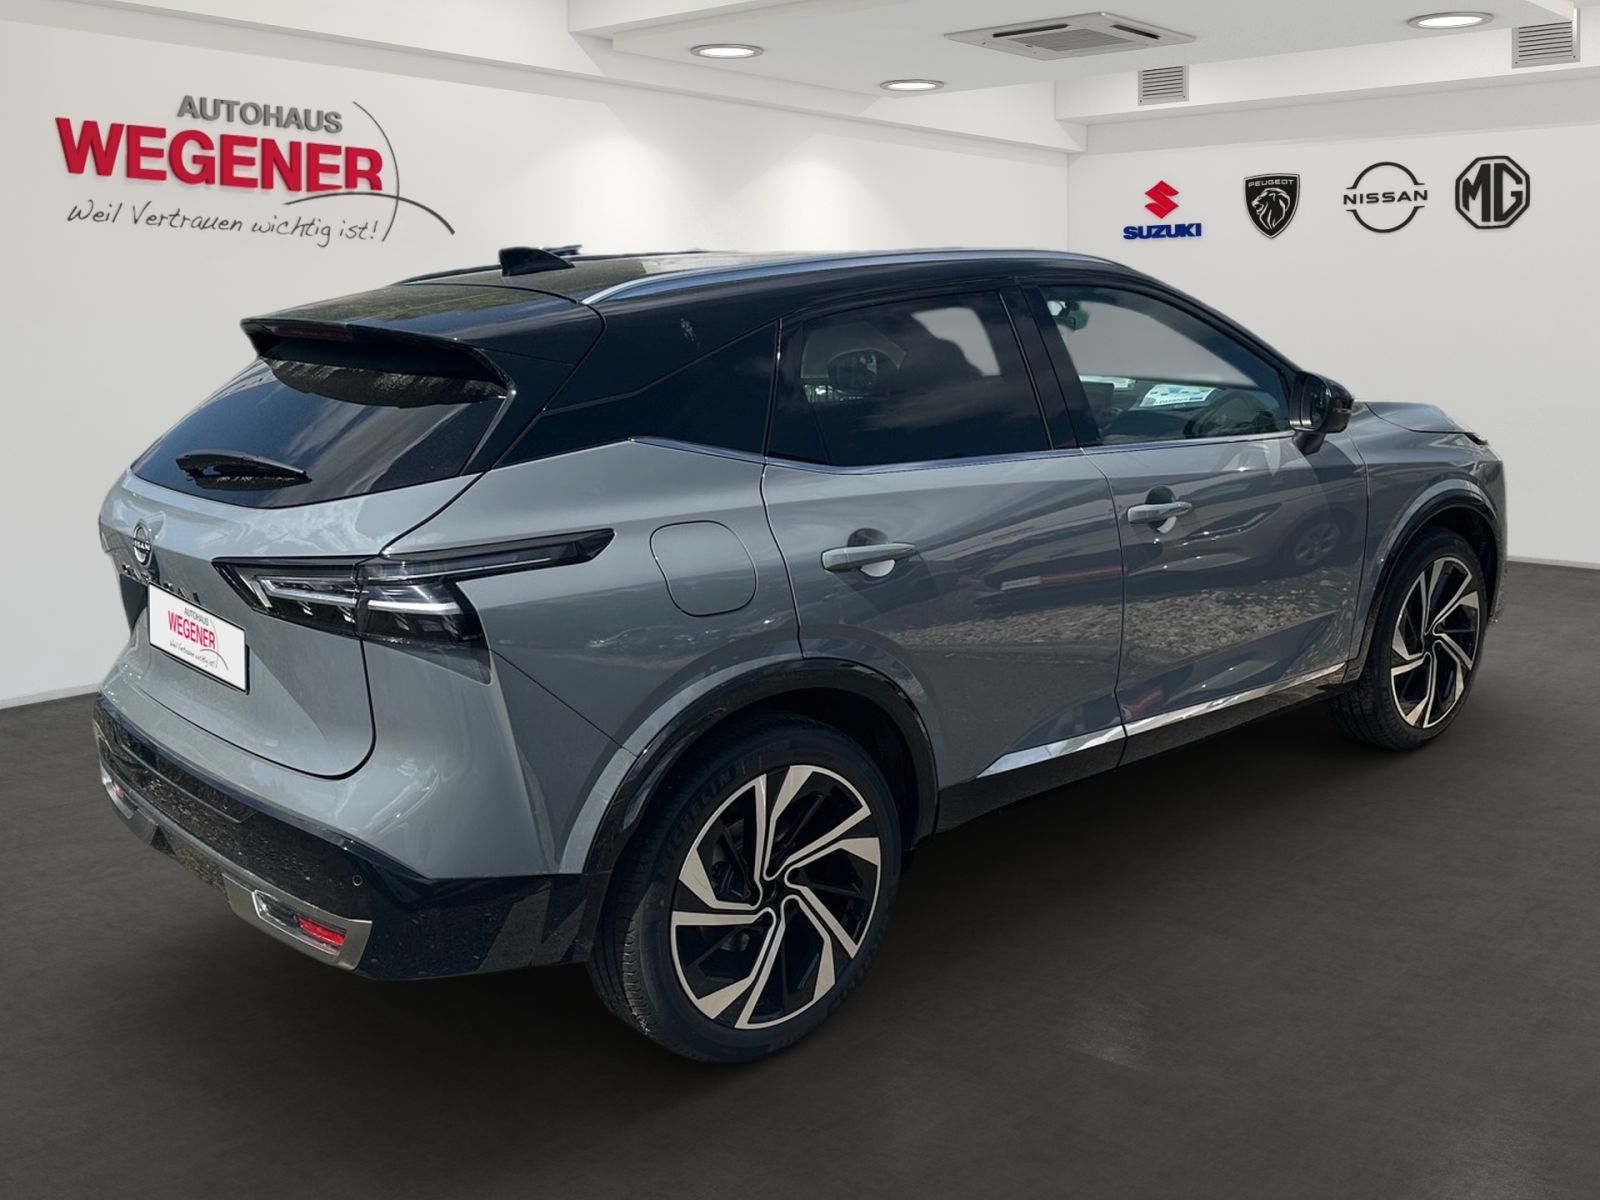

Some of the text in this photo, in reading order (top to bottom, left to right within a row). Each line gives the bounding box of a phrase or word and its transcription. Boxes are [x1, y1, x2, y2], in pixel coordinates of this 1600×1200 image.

[176, 95, 343, 134] AUTOHAUS
[55, 117, 383, 192] WEGENER
[1248, 178, 1295, 188] PEUGEOT
[1343, 189, 1428, 205] NISSAN
[1462, 163, 1523, 222] MG
[66, 199, 378, 248] Weil Vertrauen wichtig ist!
[1123, 223, 1202, 240] SUZUKI
[168, 610, 215, 649] WEGENER
